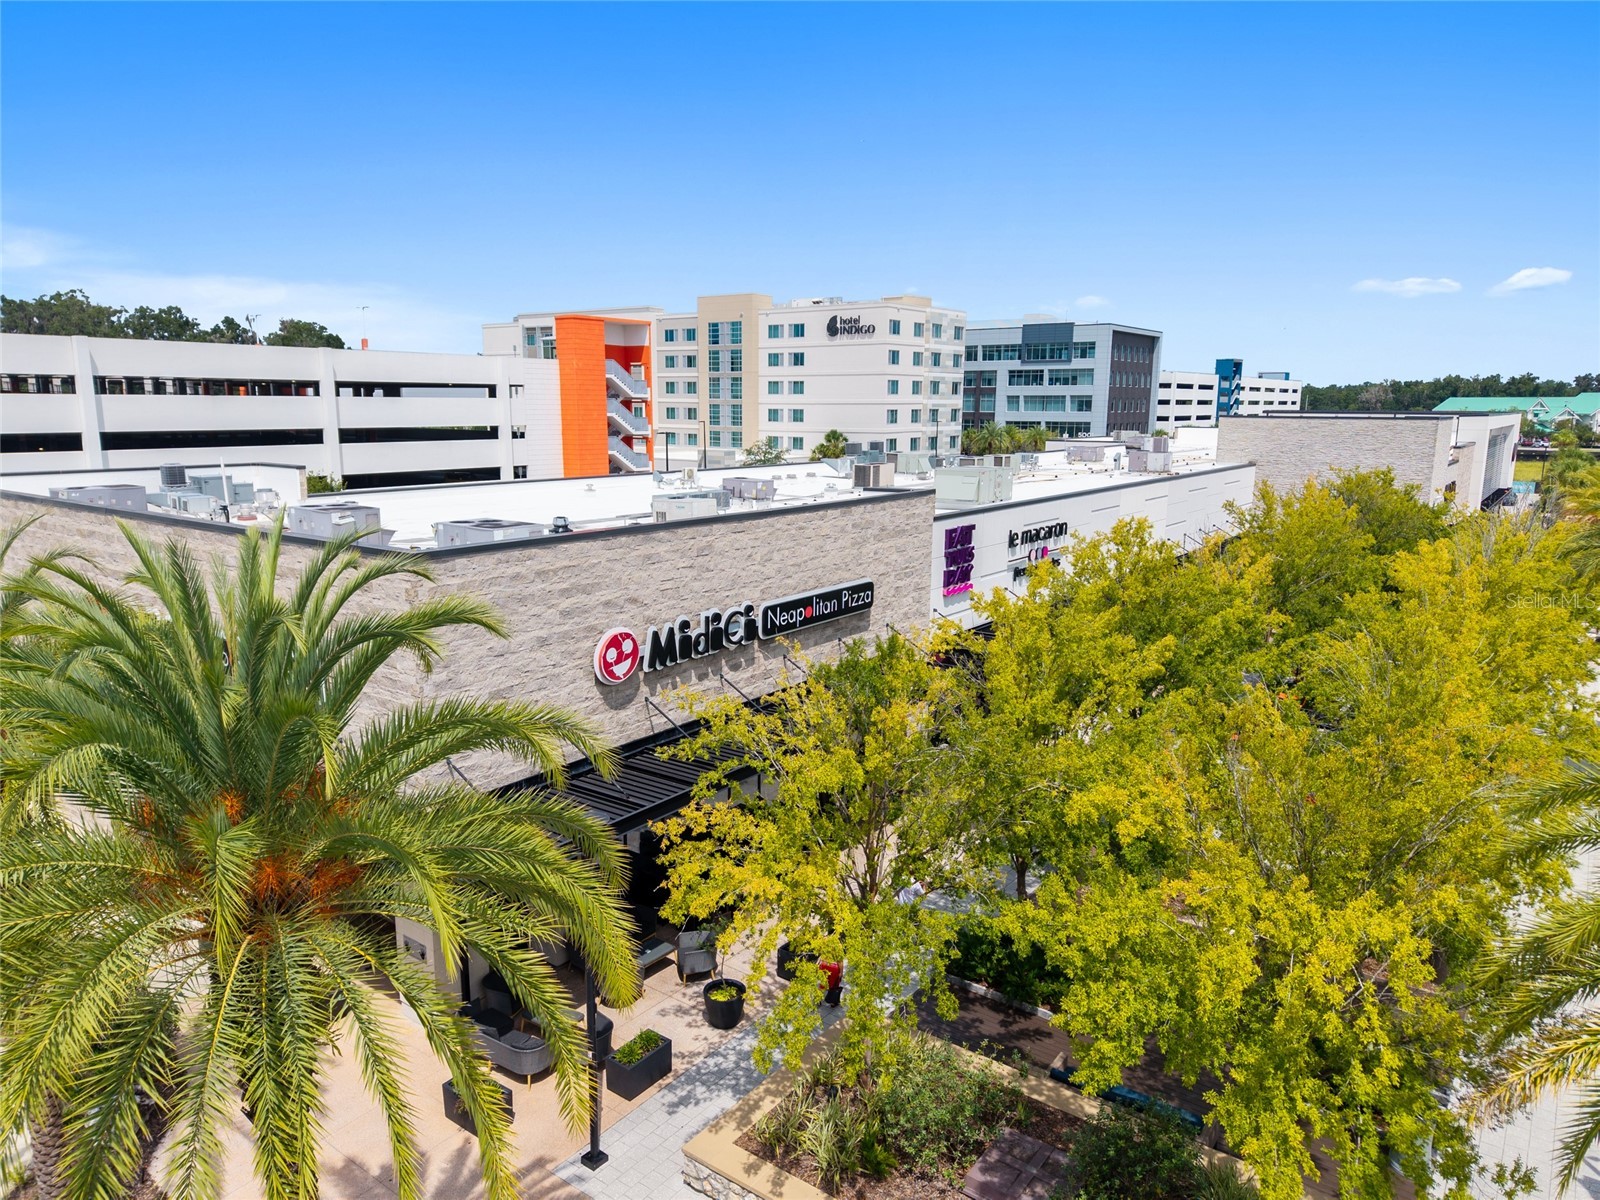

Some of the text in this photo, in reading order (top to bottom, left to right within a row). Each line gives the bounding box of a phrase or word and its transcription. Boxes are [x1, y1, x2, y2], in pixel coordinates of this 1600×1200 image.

[840, 315, 860, 325] hotel
[840, 324, 876, 335] INDIGO
[1008, 522, 1068, 548] le macaron
[645, 590, 872, 670] MidiCi Neapolitan Pizza
